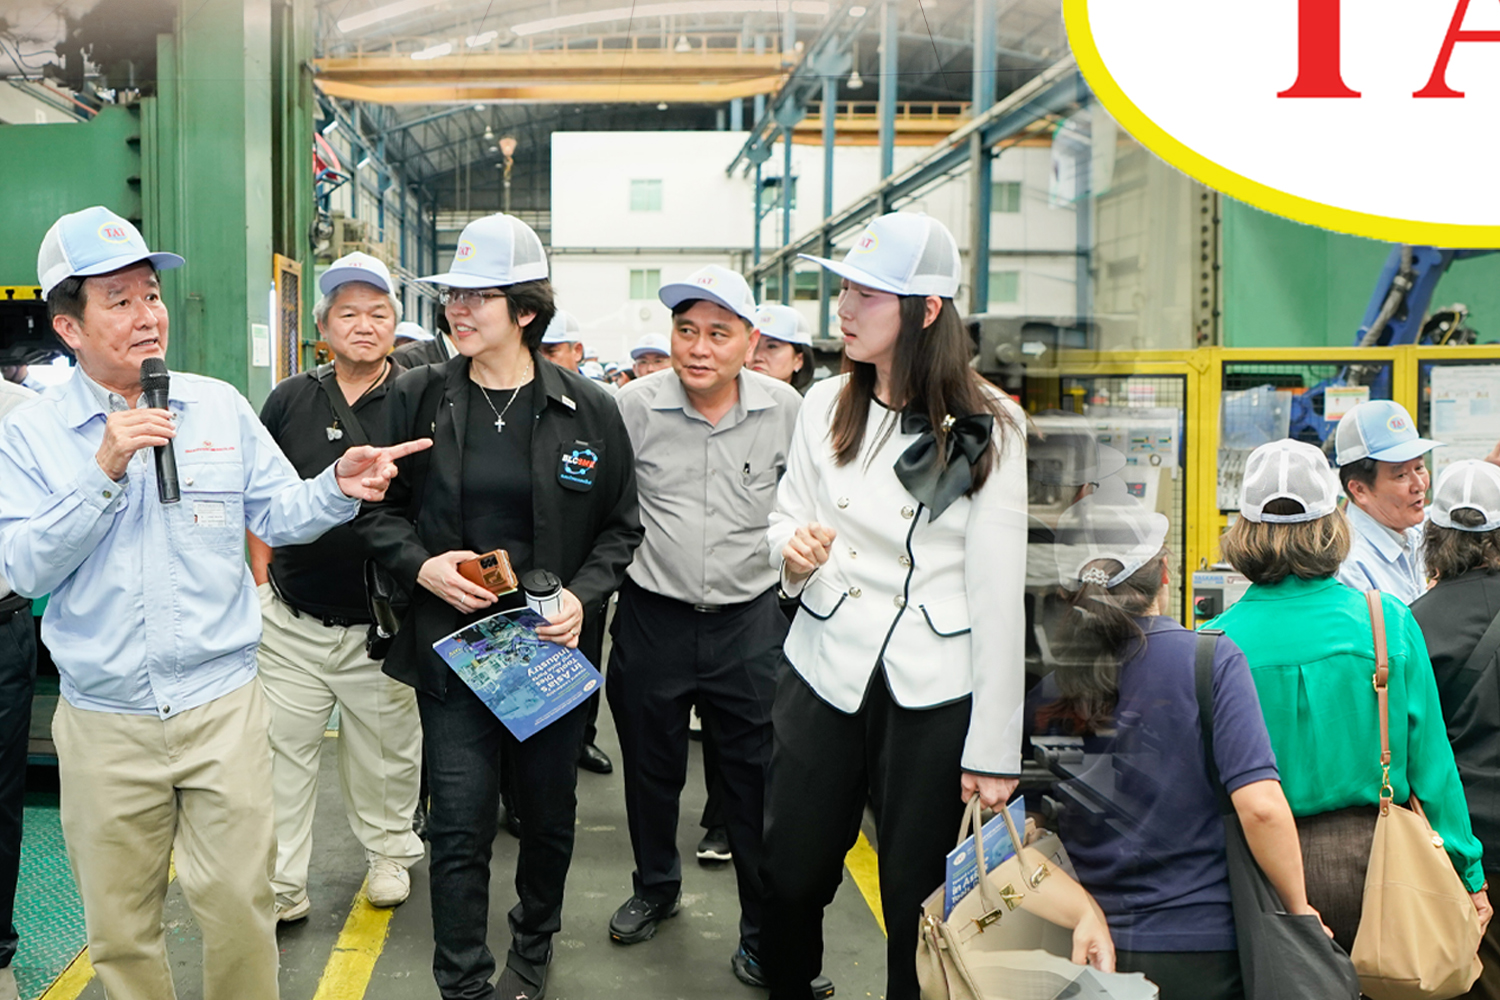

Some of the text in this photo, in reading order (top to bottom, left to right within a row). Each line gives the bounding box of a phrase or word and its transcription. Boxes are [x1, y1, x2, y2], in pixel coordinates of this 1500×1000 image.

[104, 227, 126, 238] TAT
[528, 647, 571, 677] Industry
[571, 662, 584, 673] in
[540, 670, 571, 693] Asia's
